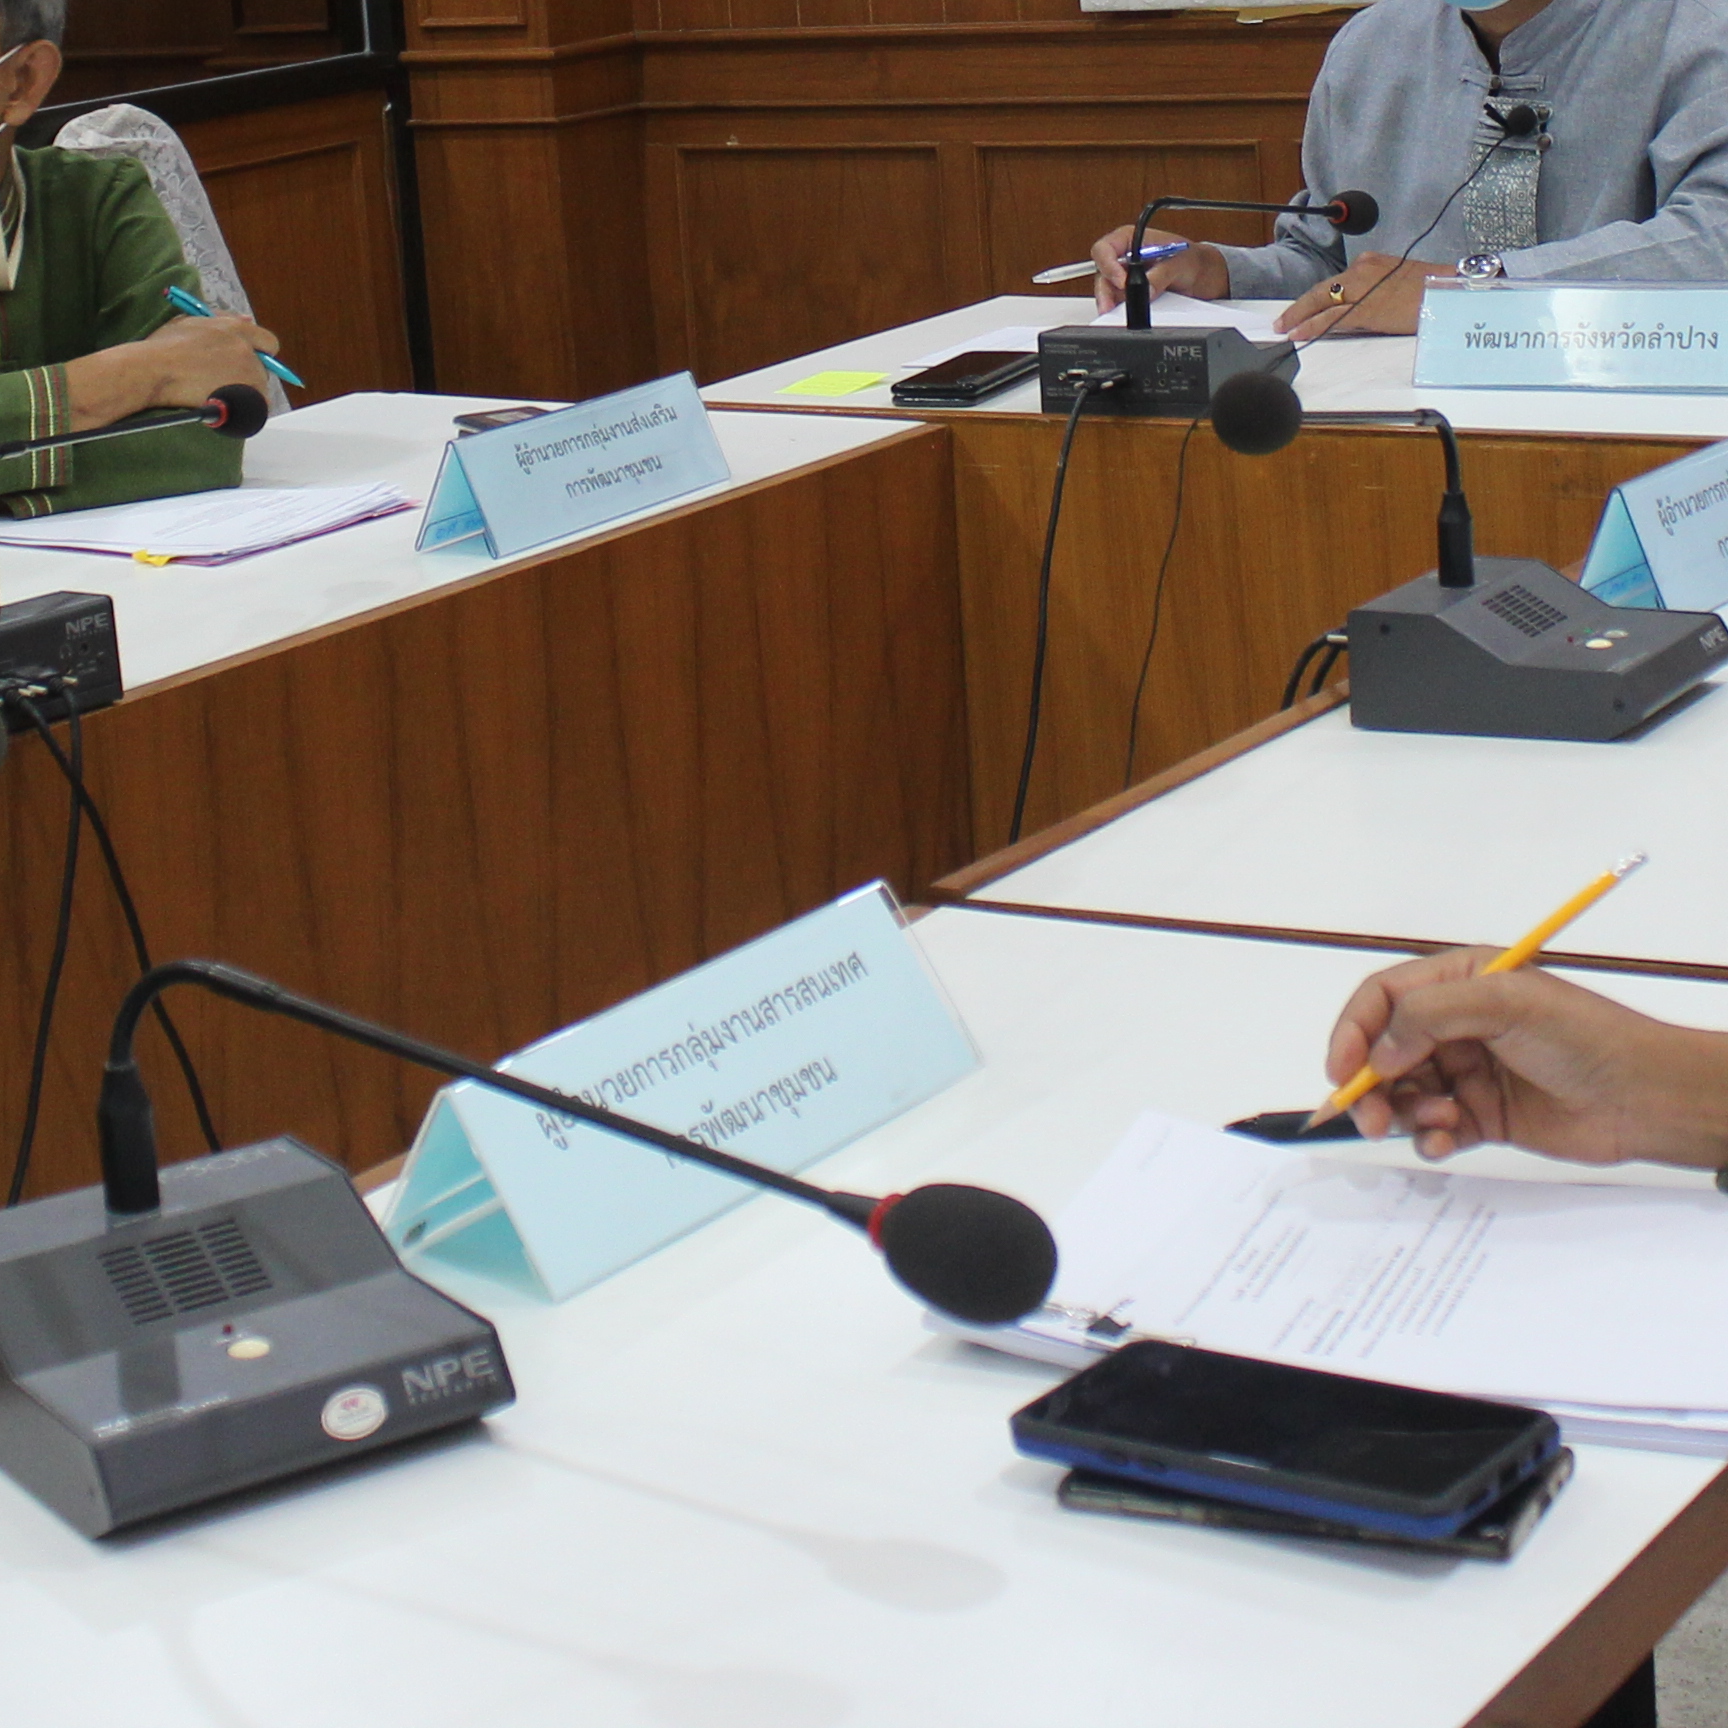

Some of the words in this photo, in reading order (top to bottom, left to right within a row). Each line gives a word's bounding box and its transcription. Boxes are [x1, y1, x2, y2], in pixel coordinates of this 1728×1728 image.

[1464, 321, 1720, 350] พัฒนาการจังหวัดลำปาง
[1163, 345, 1203, 359] NPE
[65, 611, 109, 636] NPE
[536, 950, 870, 1151] ผูนวยการกลุ่มงานสารสนเทศ
[401, 1346, 495, 1396] NPE
